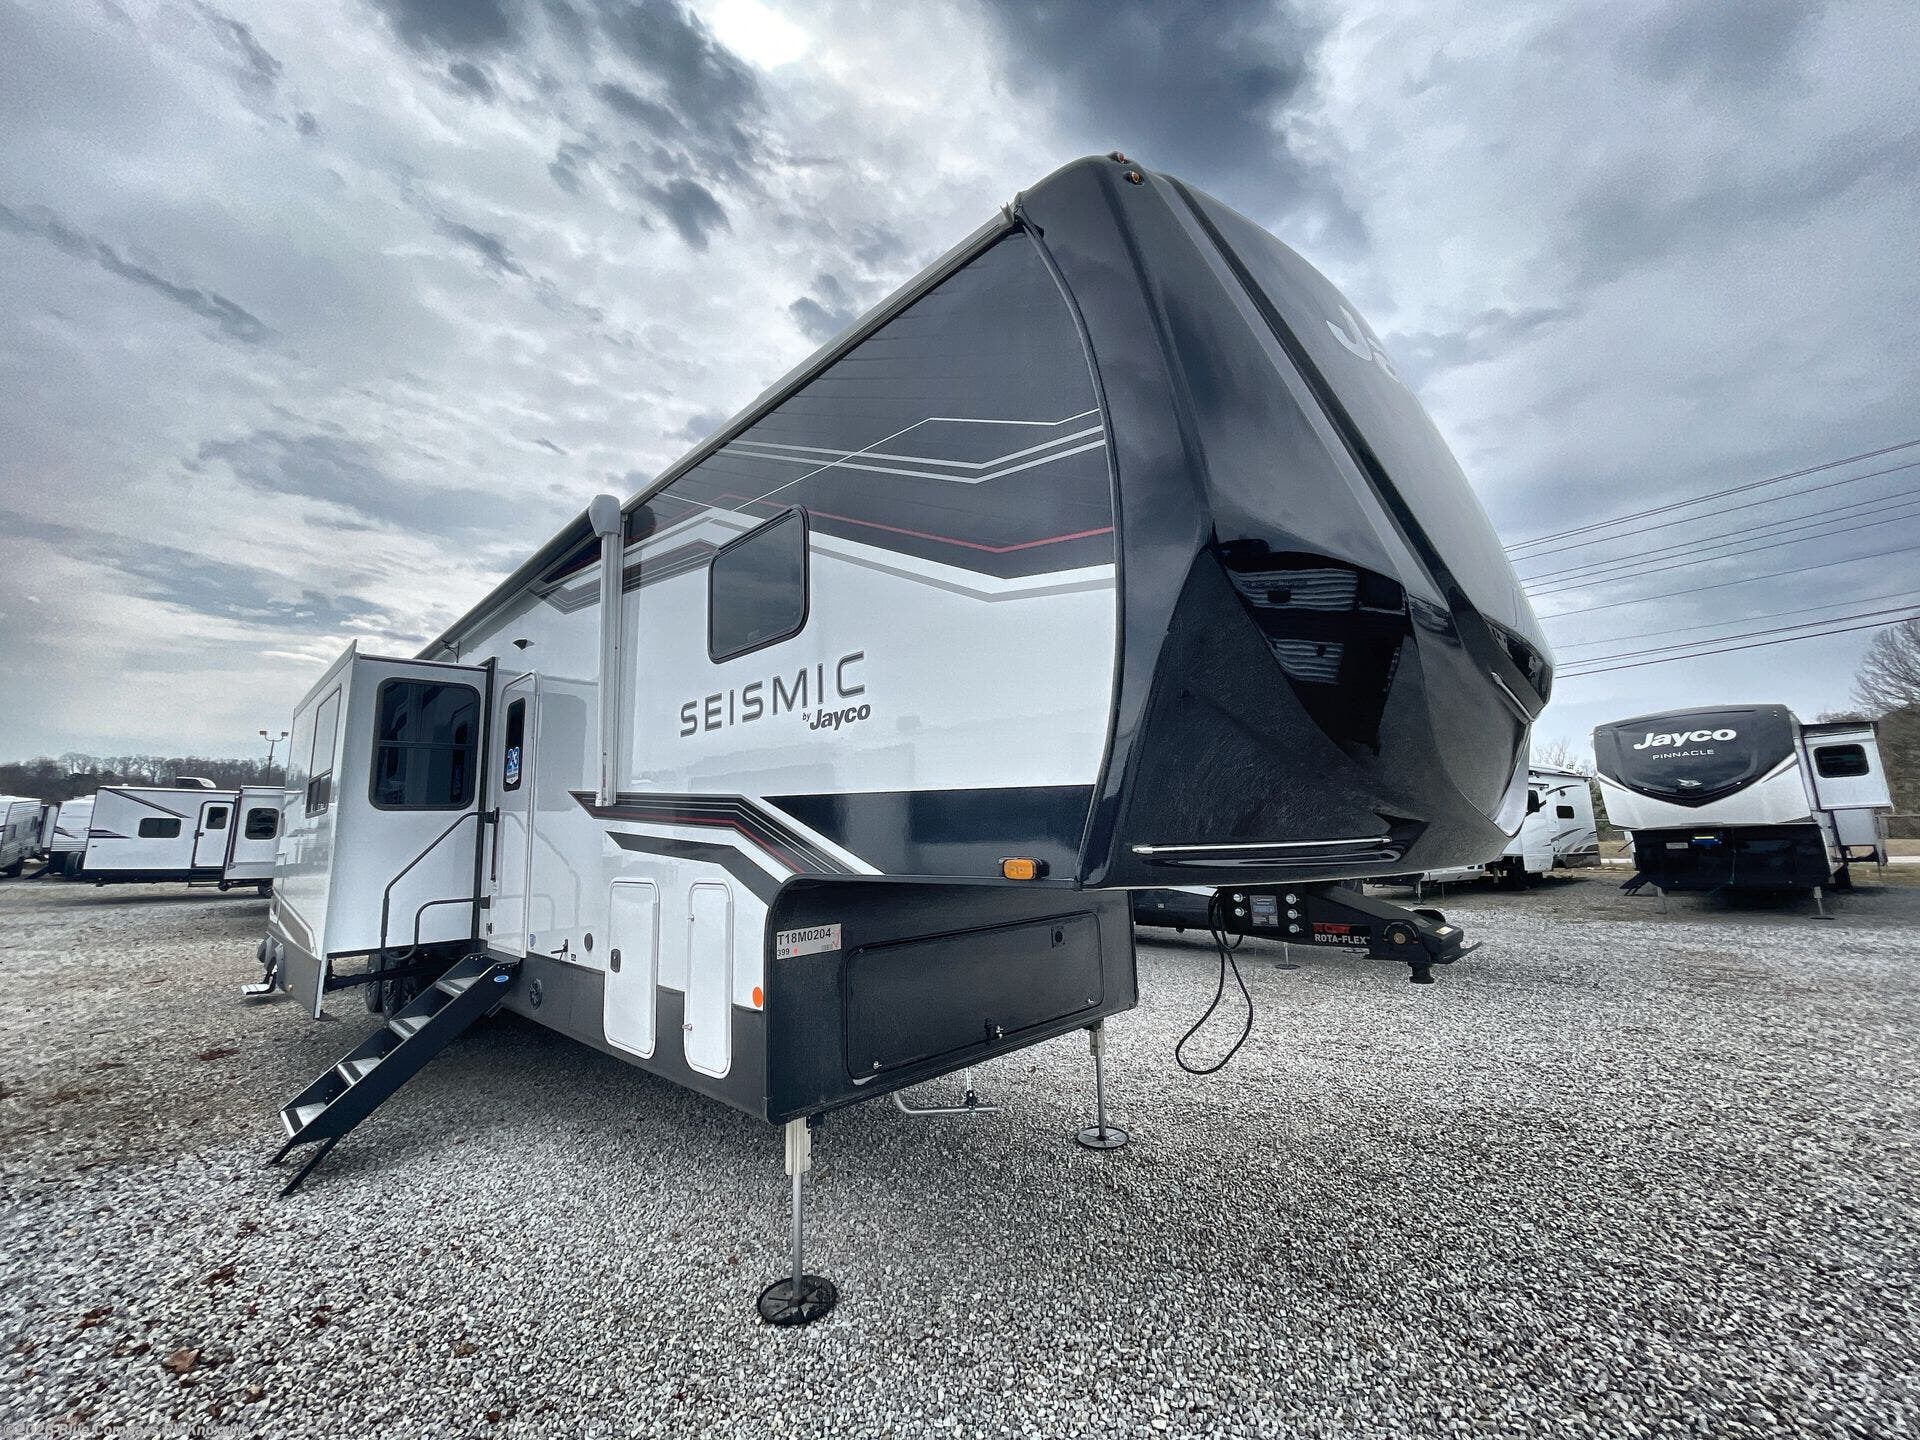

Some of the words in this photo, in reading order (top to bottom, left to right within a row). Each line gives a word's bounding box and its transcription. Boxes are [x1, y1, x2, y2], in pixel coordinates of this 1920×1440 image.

[680, 650, 866, 738] SEISMIC
[802, 712, 811, 722] by
[810, 704, 871, 730] Jayco
[1633, 728, 1737, 750] Jayco
[1652, 749, 1715, 760] PINNACLE
[777, 928, 832, 945] T18M0204
